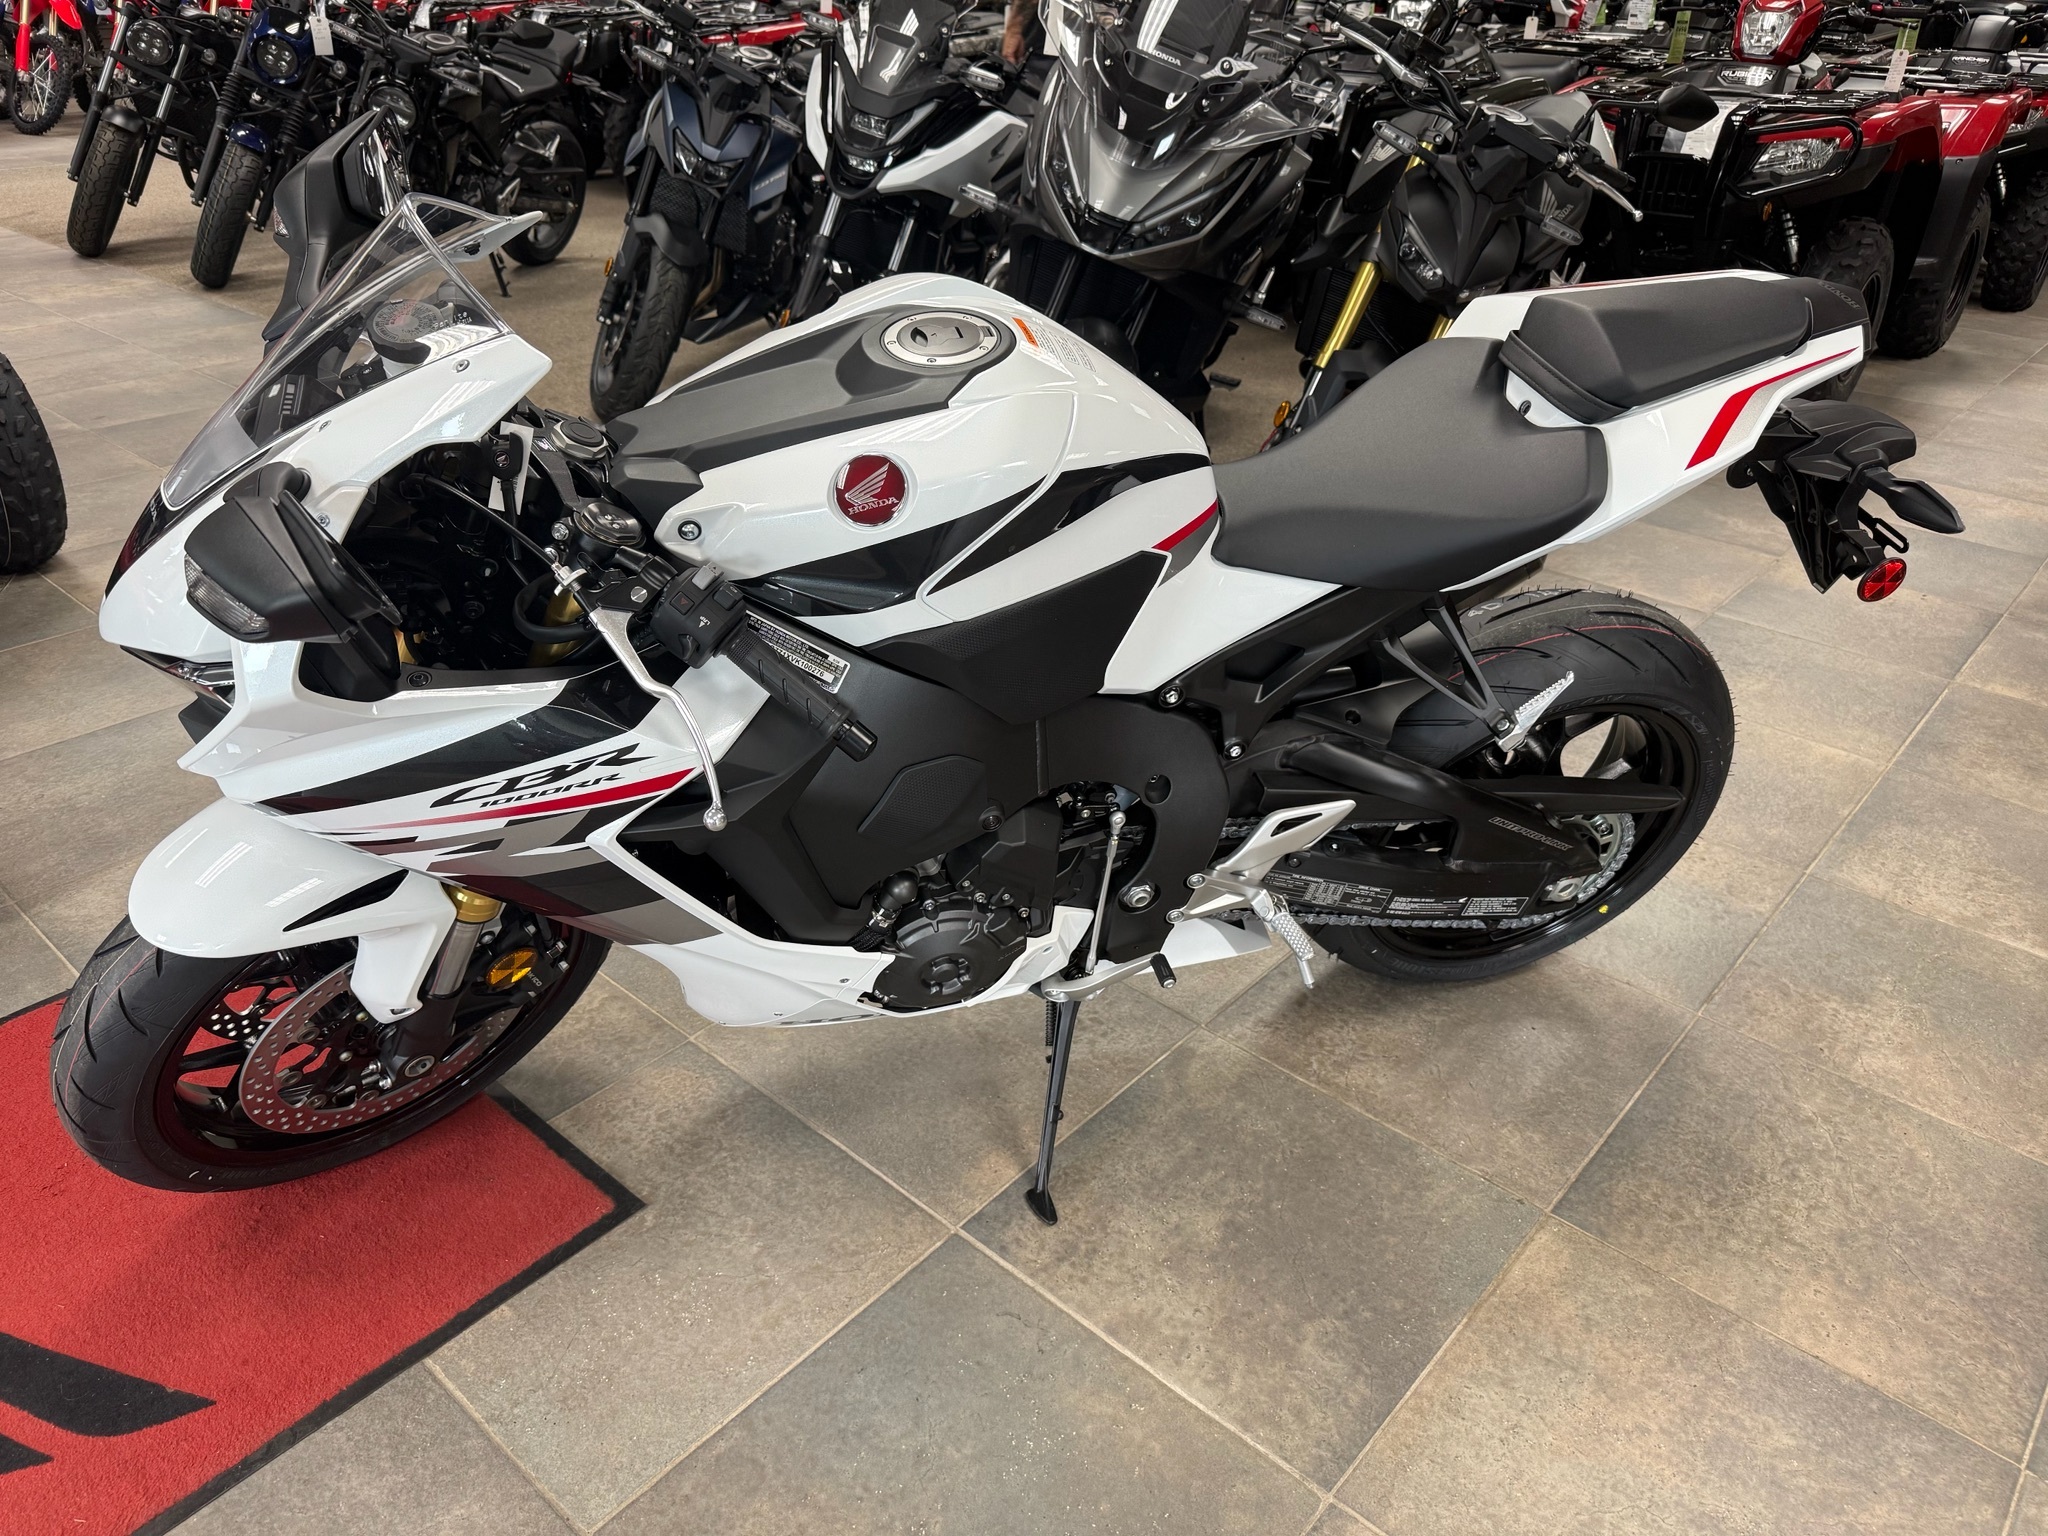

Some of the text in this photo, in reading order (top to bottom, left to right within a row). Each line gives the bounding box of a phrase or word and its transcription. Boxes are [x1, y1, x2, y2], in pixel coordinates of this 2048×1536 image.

[847, 496, 899, 515] HONDA
[430, 743, 658, 808] CBR
[479, 773, 625, 808] 1000RR
